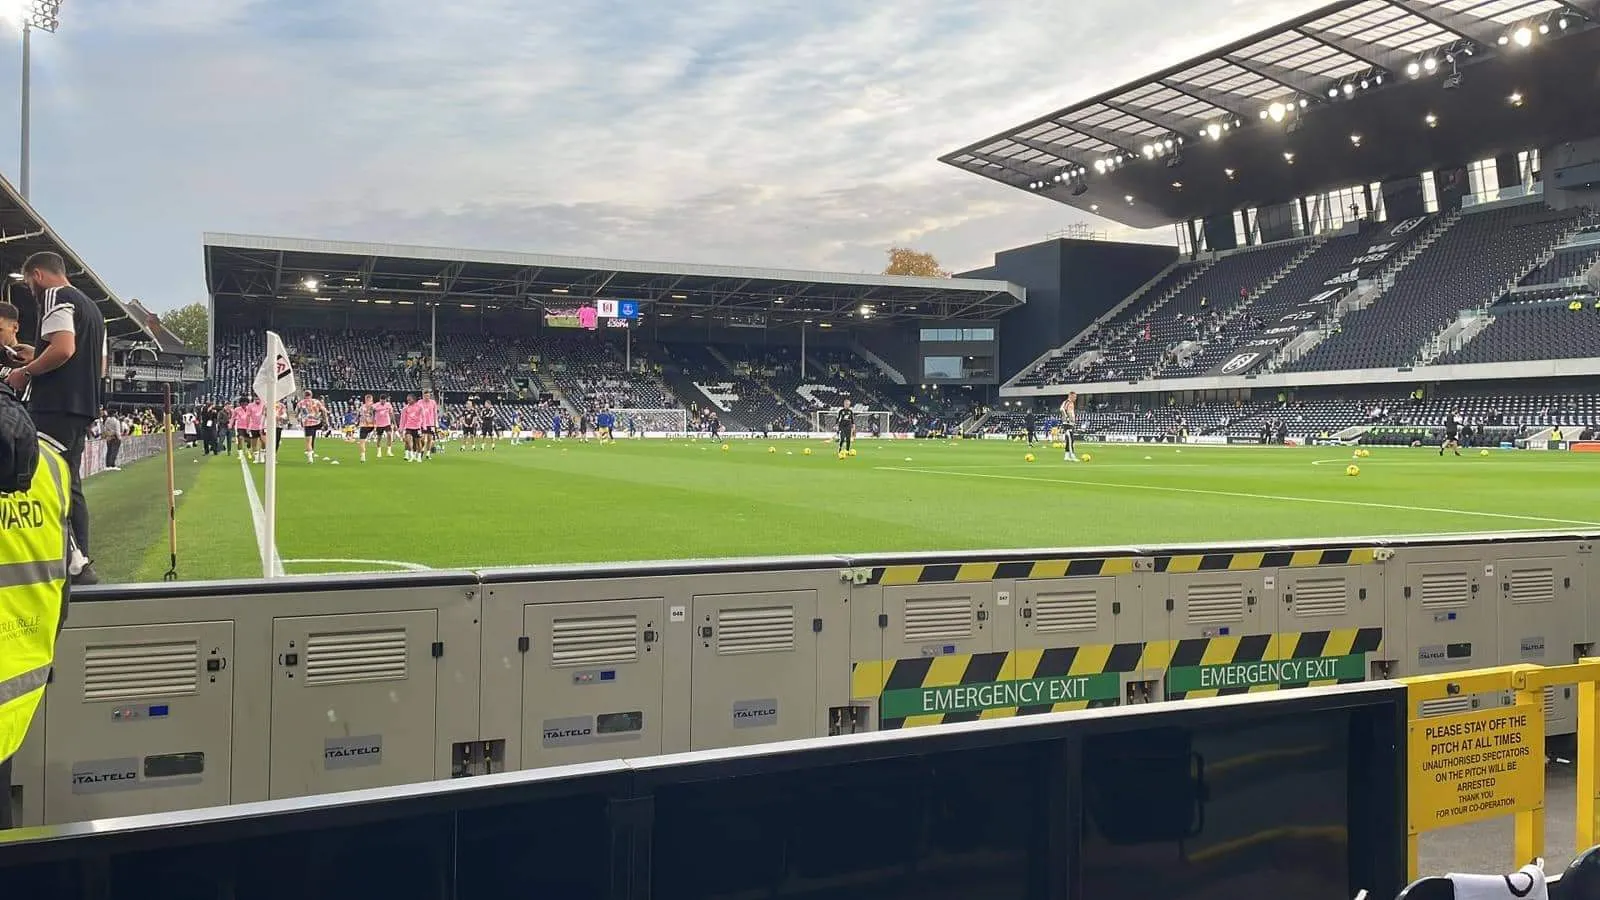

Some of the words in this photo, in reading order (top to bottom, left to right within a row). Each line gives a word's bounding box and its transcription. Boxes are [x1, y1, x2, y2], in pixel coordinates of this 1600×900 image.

[1201, 662, 1302, 687] EMERGENCY
[1305, 659, 1338, 679] EXIT
[923, 681, 1045, 711] EMERGENCY
[1050, 678, 1089, 700] EXIT
[1426, 724, 1461, 740] PLEASE
[1464, 720, 1487, 734] STAY
[1489, 717, 1506, 730] OFF
[1508, 715, 1526, 727] THE
[1431, 741, 1459, 755] PITCH
[1462, 739, 1473, 752] AT
[1475, 736, 1492, 749] ALL
[1494, 732, 1521, 746] TIMES
[1422, 753, 1481, 771] UNAUTHORISED
[1482, 747, 1529, 761] SPECTATORS
[1435, 773, 1447, 783] ON
[1449, 770, 1463, 780] THE
[1465, 766, 1487, 778] PITCH
[1488, 763, 1506, 774] WILL
[1507, 761, 1517, 771] BE
[1457, 778, 1496, 792] ARRESTED
[1436, 808, 1449, 819] FOR
[1450, 805, 1468, 816] YOUR
[1469, 798, 1515, 812] CO-OPERATION
[1459, 793, 1480, 803] THANK
[1481, 791, 1494, 800] YOU
